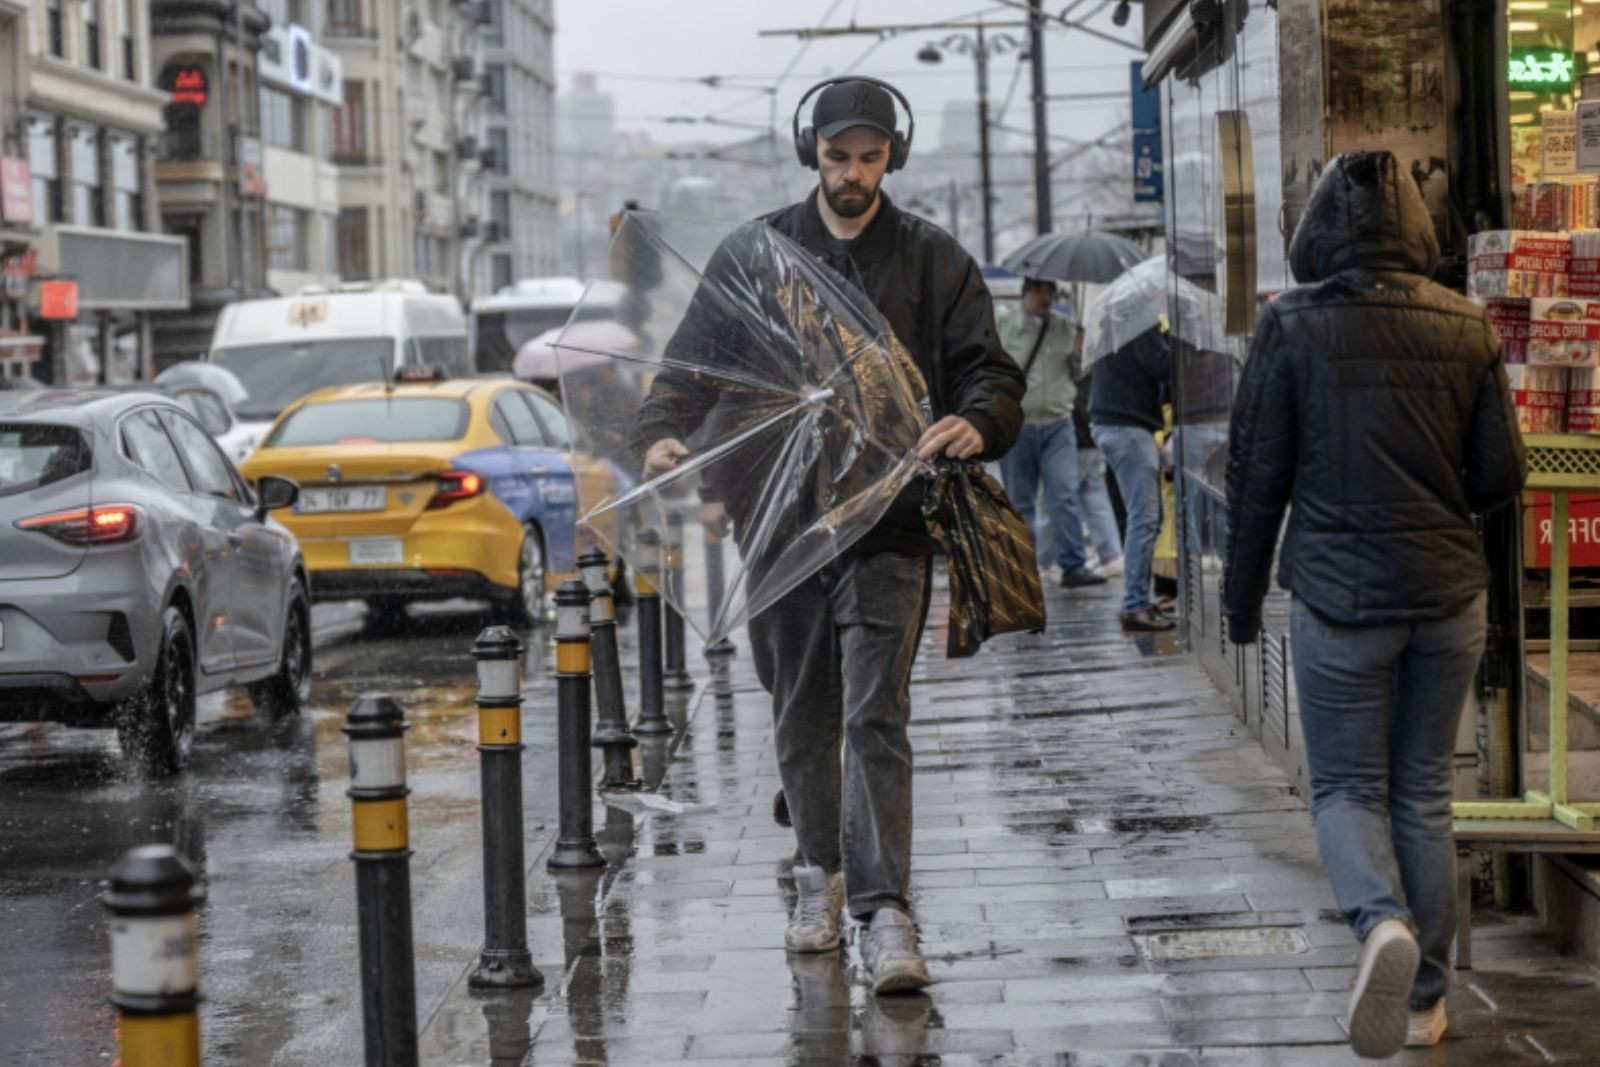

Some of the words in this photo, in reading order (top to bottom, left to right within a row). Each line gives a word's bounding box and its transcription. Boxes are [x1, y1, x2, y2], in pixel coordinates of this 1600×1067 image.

[1515, 255, 1542, 270] SPECIAL
[1543, 258, 1566, 272] OFFER
[1529, 322, 1559, 337] SPECIAL
[1562, 325, 1588, 338] OFFER
